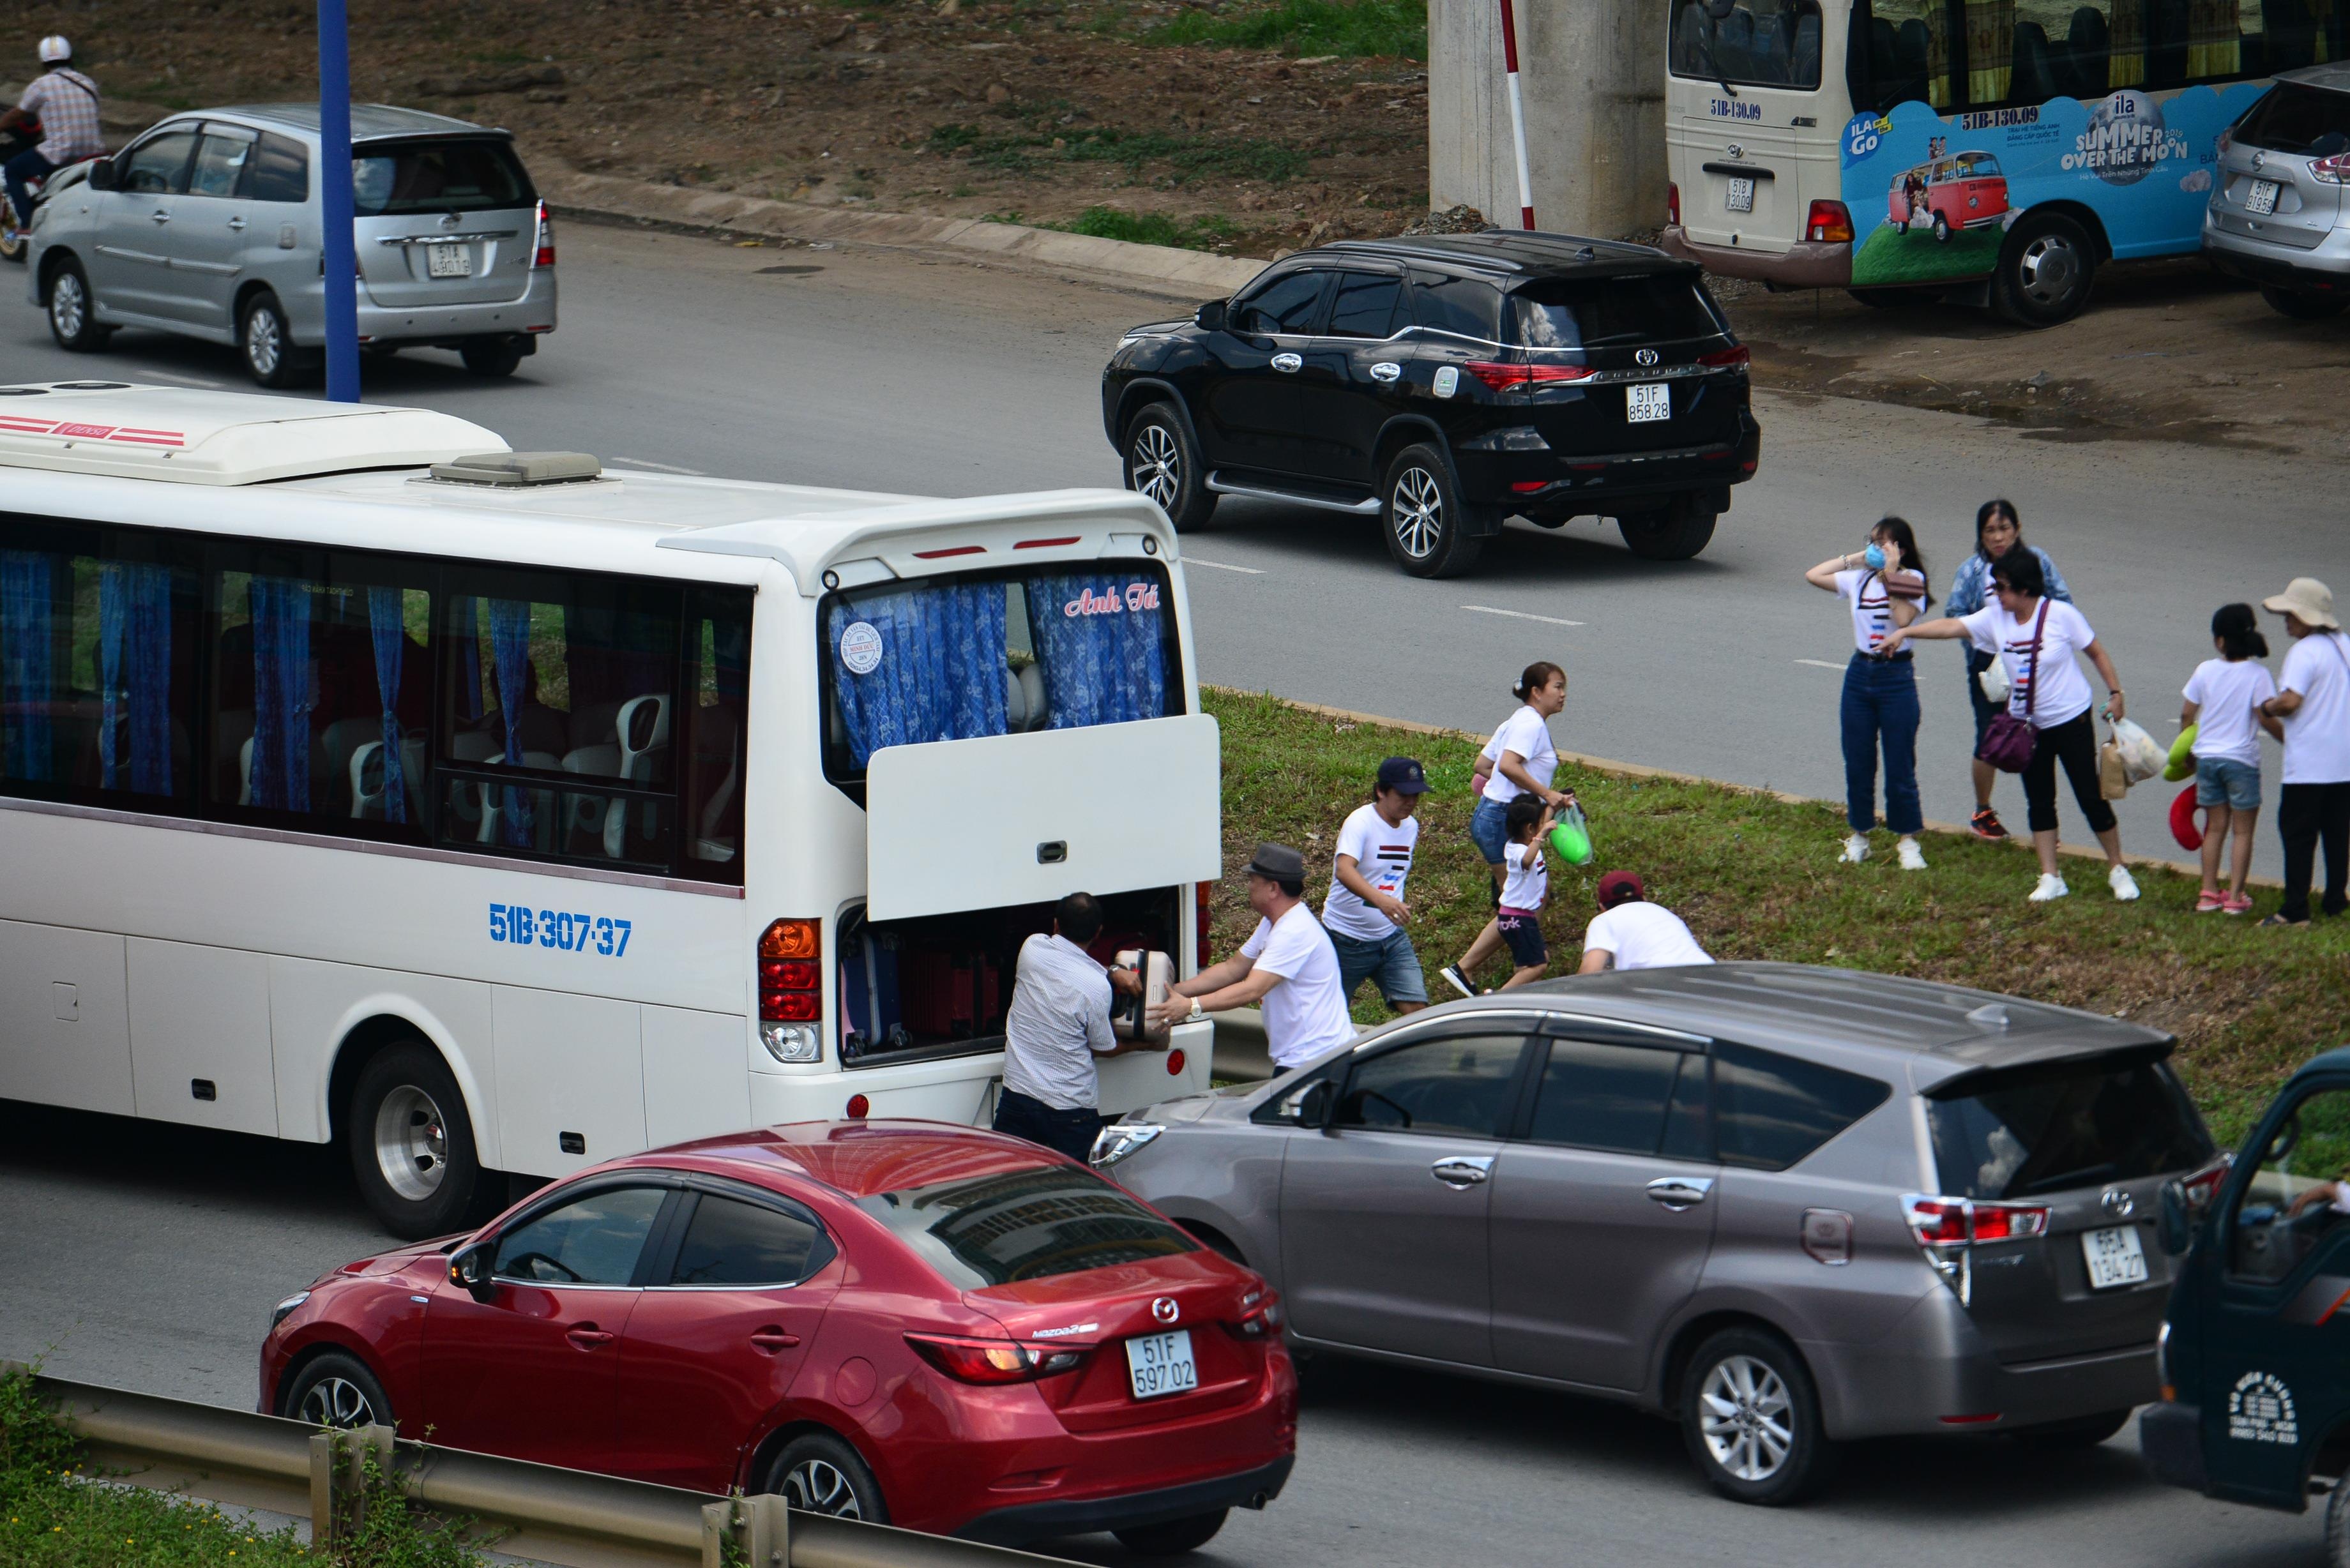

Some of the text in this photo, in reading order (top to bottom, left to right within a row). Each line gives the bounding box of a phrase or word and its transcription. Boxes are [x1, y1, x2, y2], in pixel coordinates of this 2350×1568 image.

[1711, 99, 1761, 121] 51B-130.09
[2116, 95, 2134, 114] ila
[1851, 120, 1872, 137] ILA
[1962, 107, 2038, 131] 51B-130.09
[2076, 123, 2163, 151] SUMMER
[2165, 129, 2183, 138] 2019
[2061, 138, 2188, 170] OVER THE MOON
[1733, 180, 1747, 193] 51B
[2255, 181, 2273, 197] 51F
[1637, 386, 1658, 403] 51F
[1629, 403, 1669, 421] 858.28
[68, 426, 109, 435] DENSO
[1065, 583, 1160, 617] Anh Tú
[1142, 1335, 1174, 1364] 51F
[1135, 1361, 1194, 1393] 597.02
